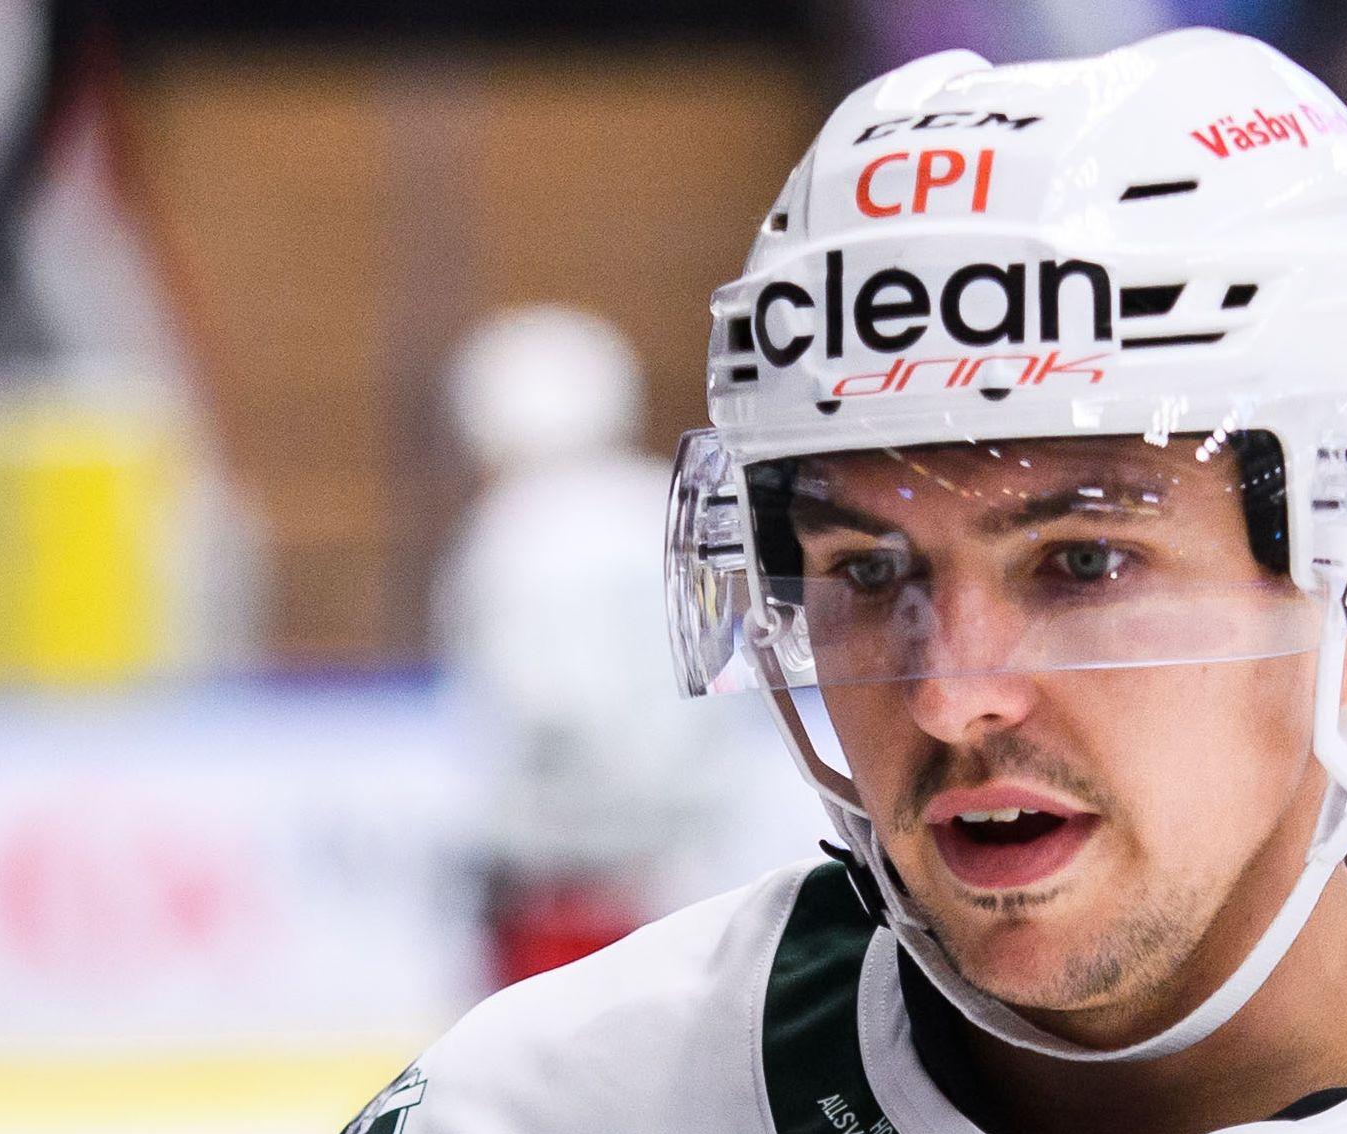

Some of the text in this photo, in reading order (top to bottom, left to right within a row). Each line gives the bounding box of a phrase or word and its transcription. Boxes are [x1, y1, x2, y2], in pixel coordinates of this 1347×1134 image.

[853, 111, 1044, 145] CCM
[1191, 109, 1309, 159] Väsby
[855, 149, 995, 218] CPI
[755, 250, 1113, 368] clean
[832, 351, 1114, 397] drink
